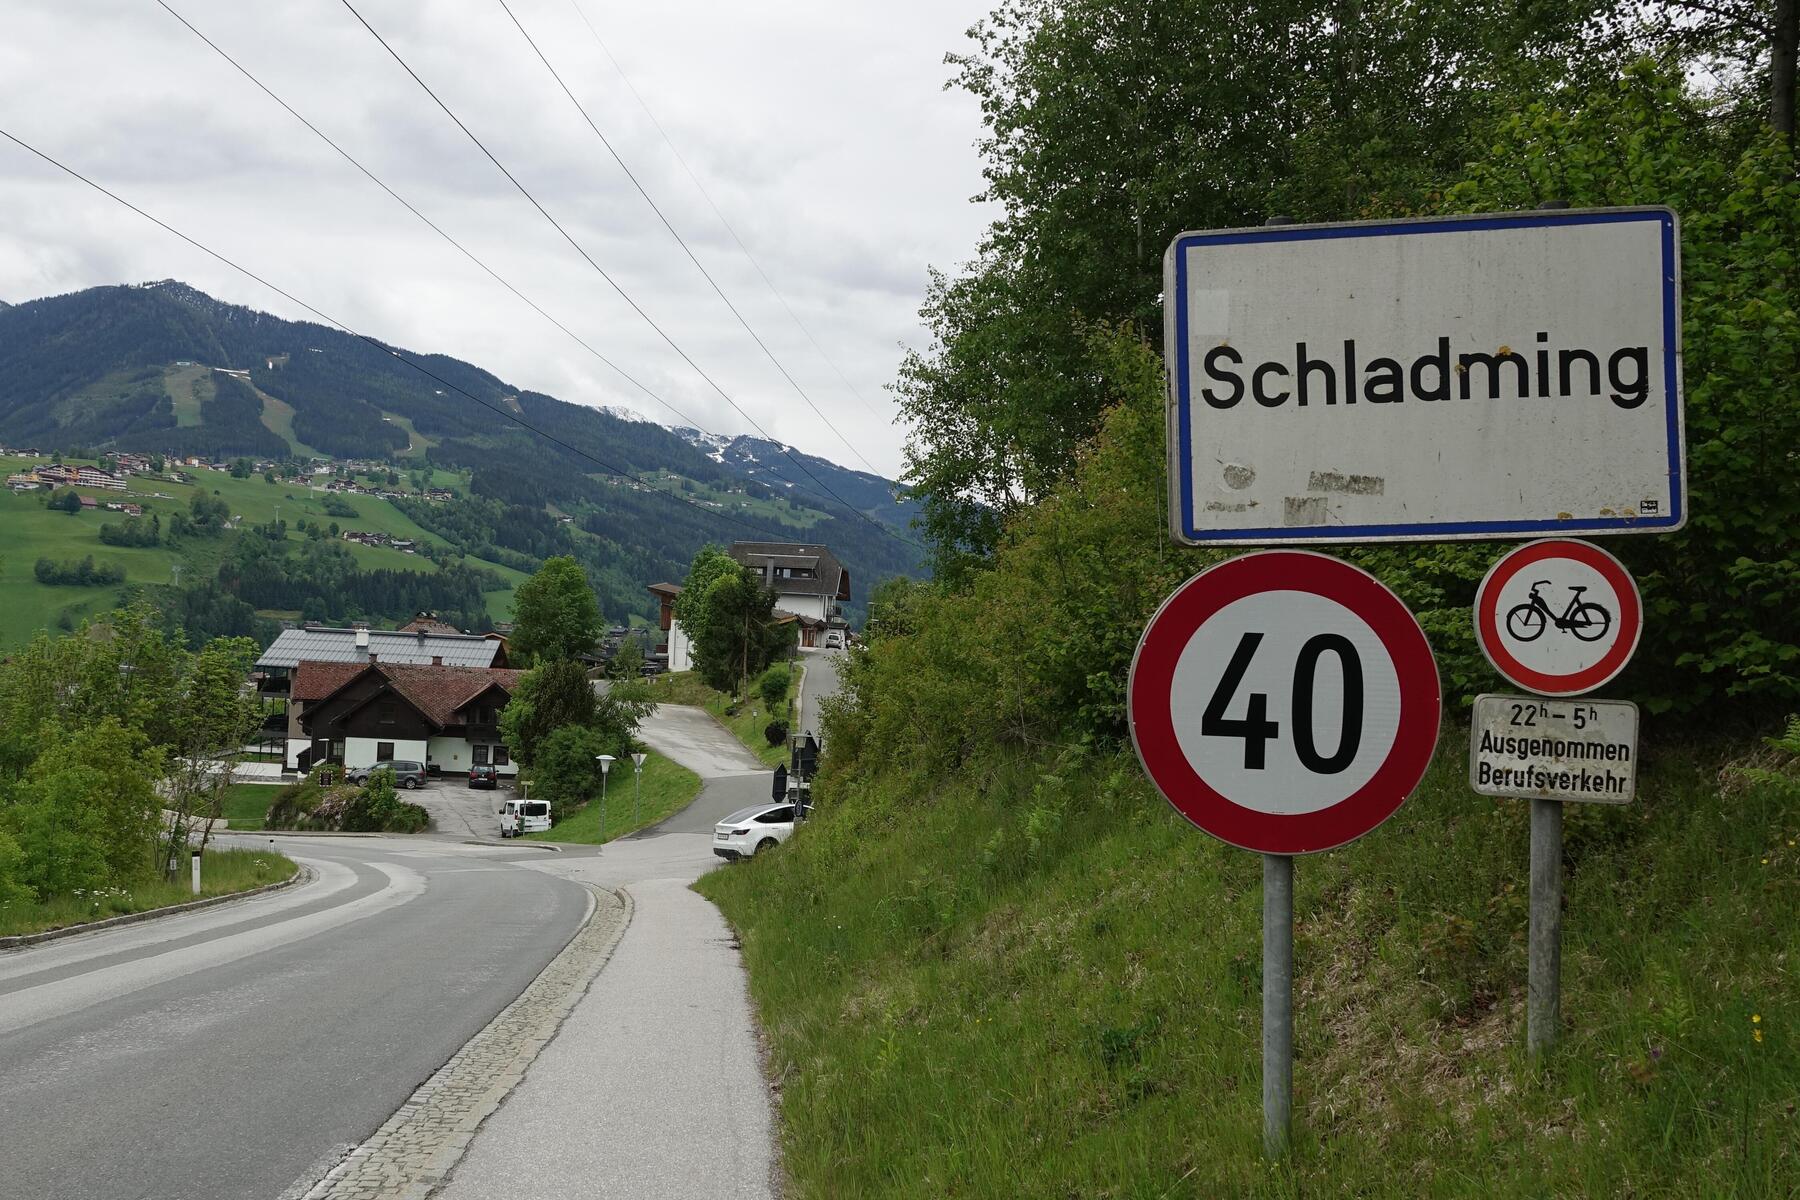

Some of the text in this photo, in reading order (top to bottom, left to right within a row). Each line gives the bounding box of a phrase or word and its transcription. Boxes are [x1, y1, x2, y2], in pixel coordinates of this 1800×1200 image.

[1202, 332, 1649, 410] Schladming
[1201, 632, 1364, 775] 40
[1479, 729, 1630, 762] Ausgenommen
[1478, 761, 1627, 794] Berufsverkehr
